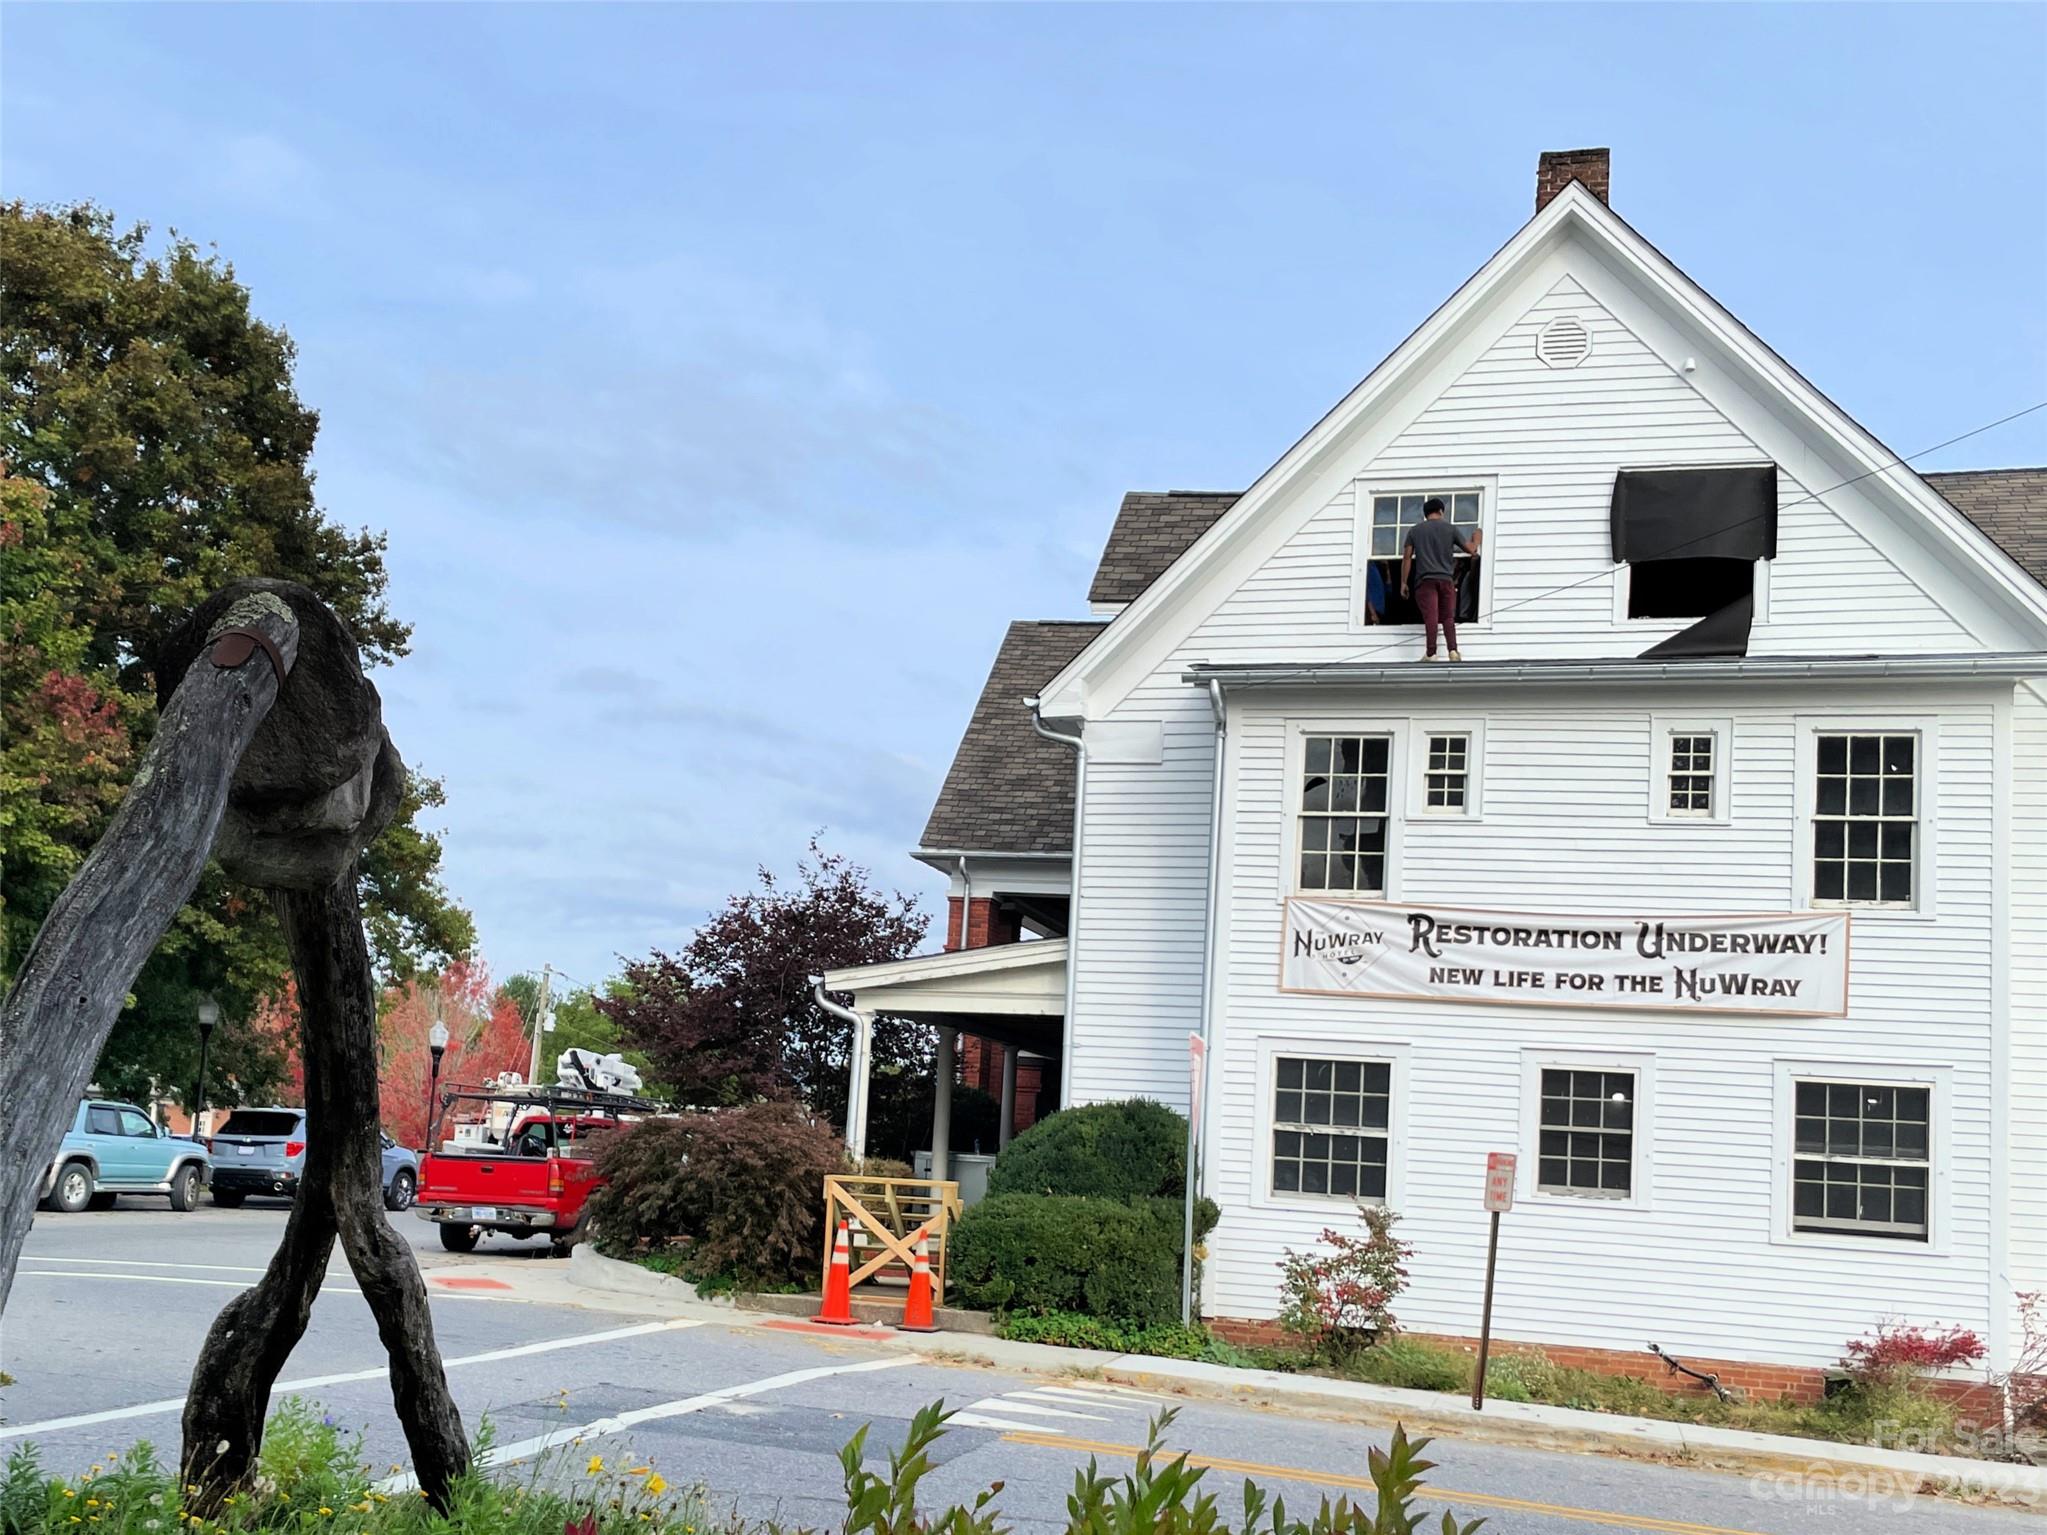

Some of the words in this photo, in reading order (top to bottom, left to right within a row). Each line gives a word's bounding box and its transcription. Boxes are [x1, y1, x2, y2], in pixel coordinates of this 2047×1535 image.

[1407, 913, 1623, 958] RESTORATION
[1635, 921, 1828, 960] UNDERWAY!
[1429, 967, 1484, 986] NEW
[1493, 970, 1545, 989] LIFE
[1555, 973, 1605, 992] FOR
[1614, 975, 1664, 993] THE
[1492, 1176, 1508, 1187] ANY
[1490, 1191, 1508, 1202] TIME
